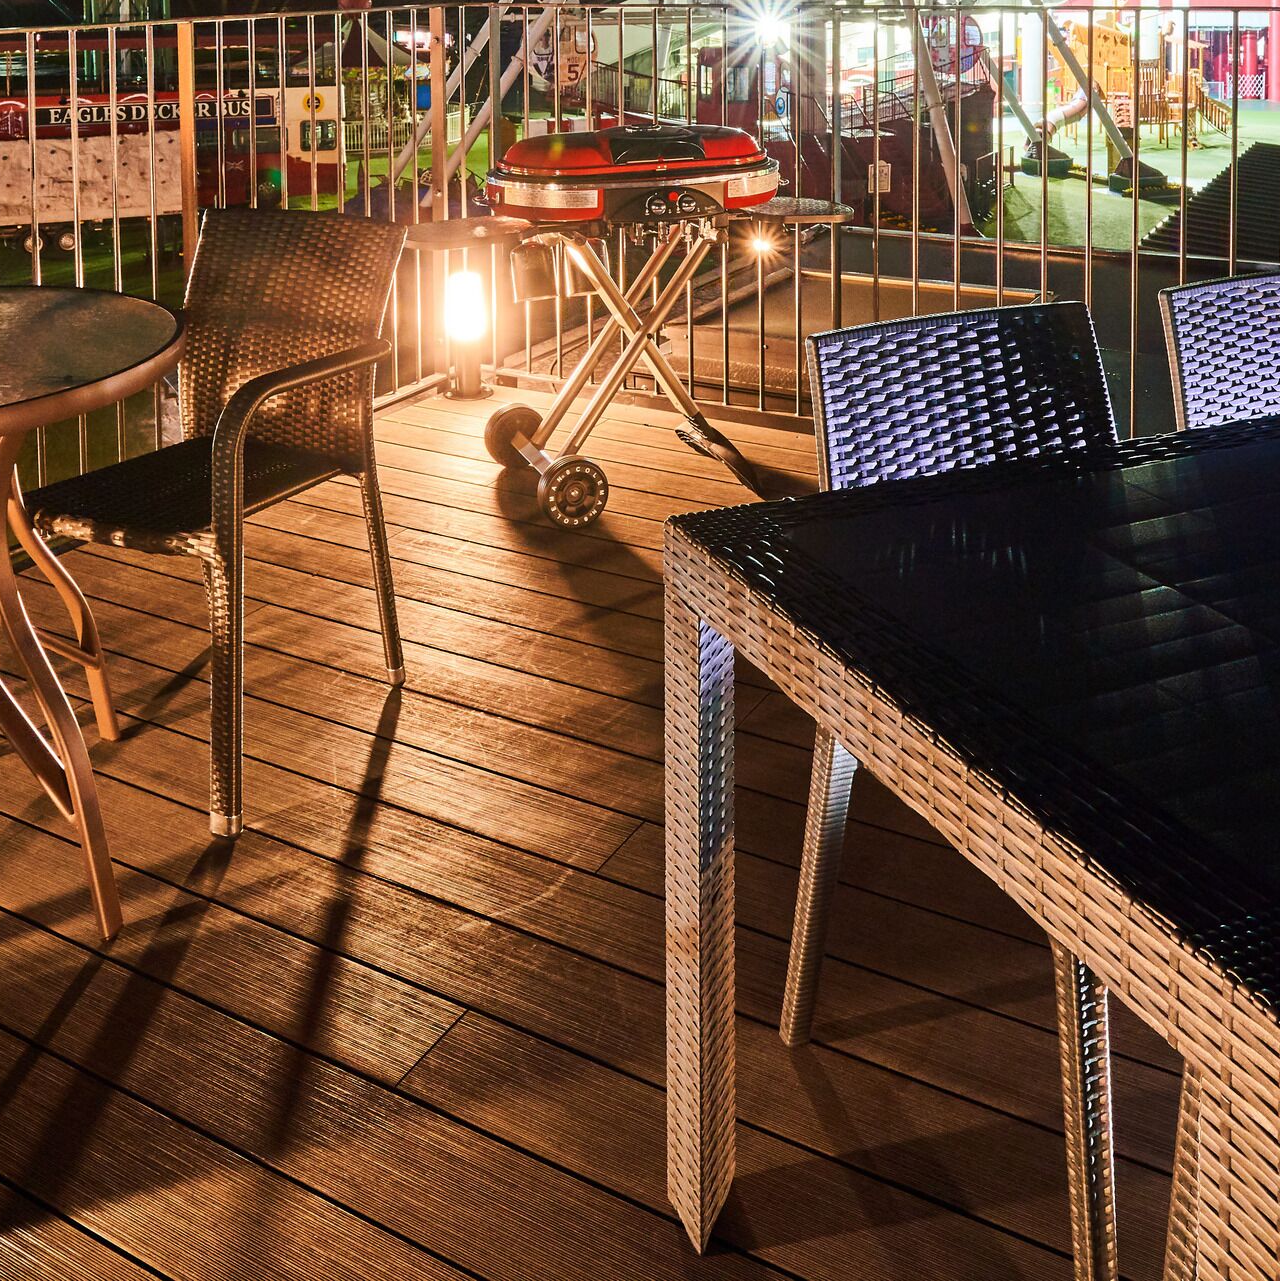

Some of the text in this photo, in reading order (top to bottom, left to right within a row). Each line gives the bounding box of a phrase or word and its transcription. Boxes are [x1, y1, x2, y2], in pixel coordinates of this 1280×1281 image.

[567, 64, 579, 81] 5
[49, 106, 127, 124] EAGLES
[216, 100, 251, 117] BUS
[549, 476, 579, 525] COLEMAN
[575, 466, 605, 515] COLEMAN
